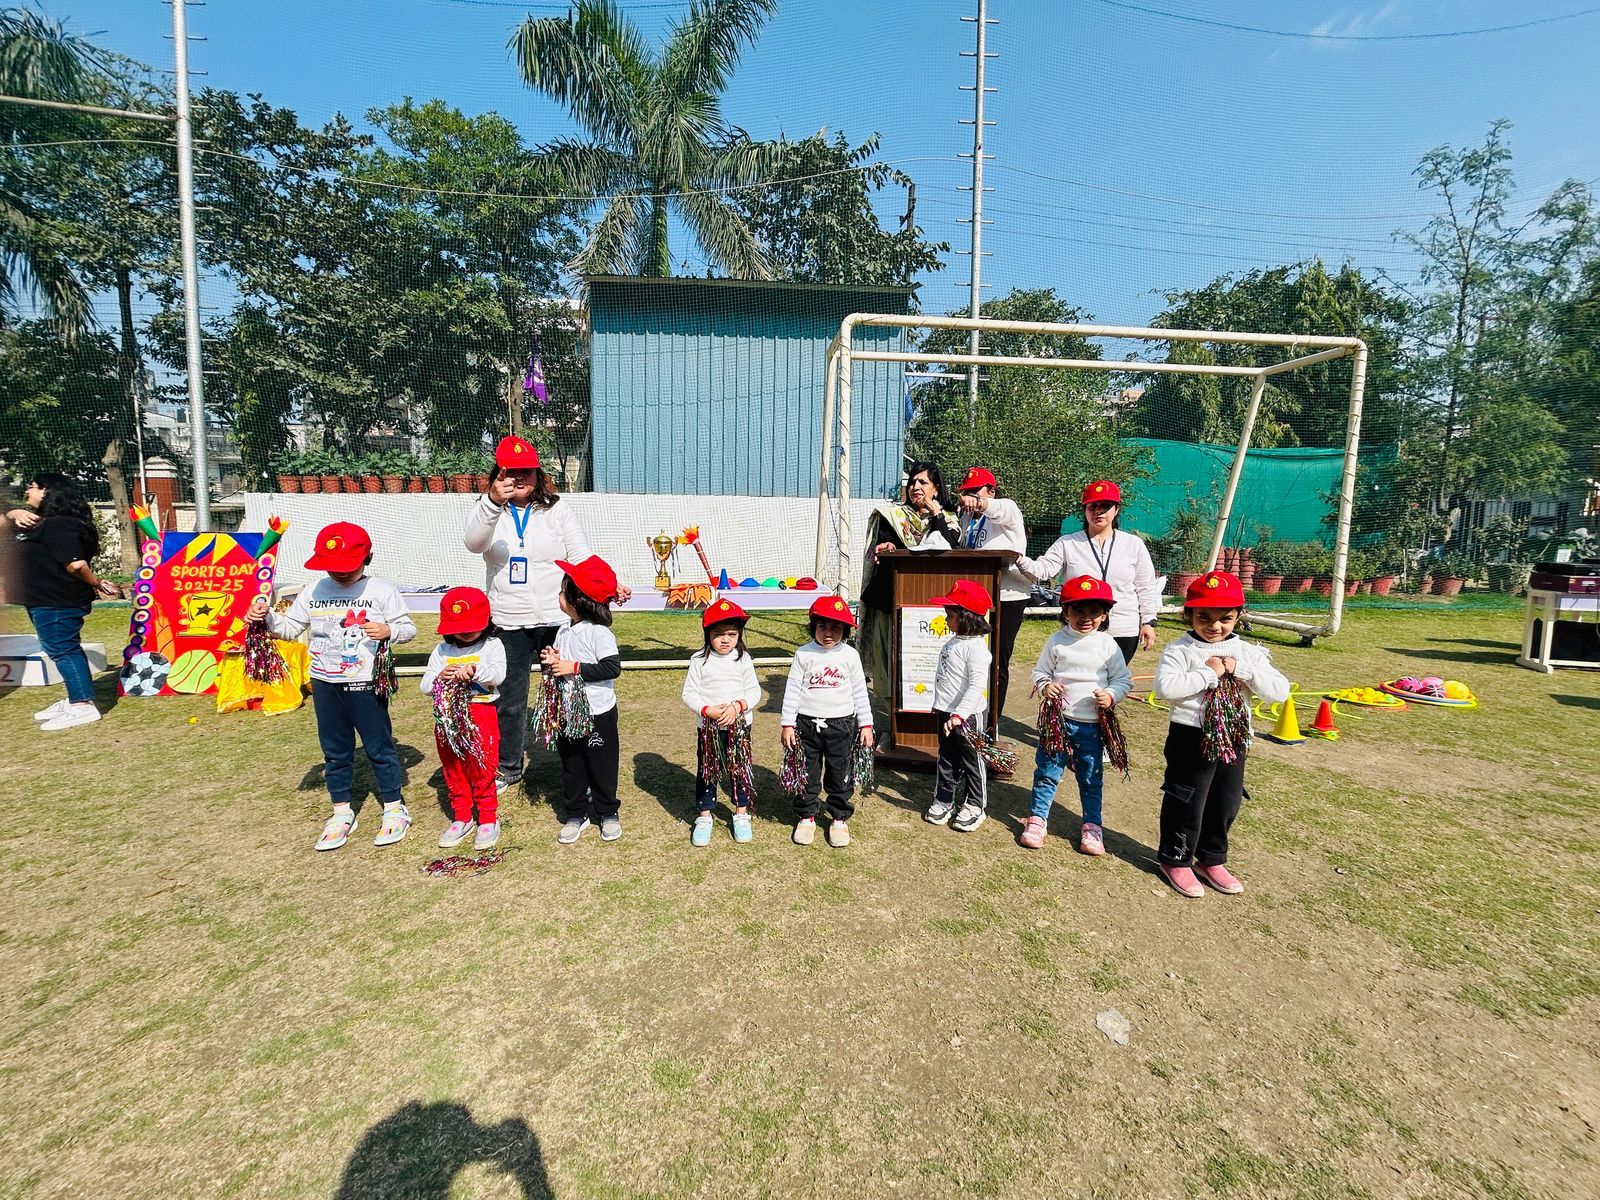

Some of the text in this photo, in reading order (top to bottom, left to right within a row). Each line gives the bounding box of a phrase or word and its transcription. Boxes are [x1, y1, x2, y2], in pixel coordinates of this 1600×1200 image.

[170, 563, 257, 579] SPORTS DAY
[173, 579, 244, 592] 2024-25
[350, 599, 373, 609] RUN
[0, 663, 15, 683] 2
